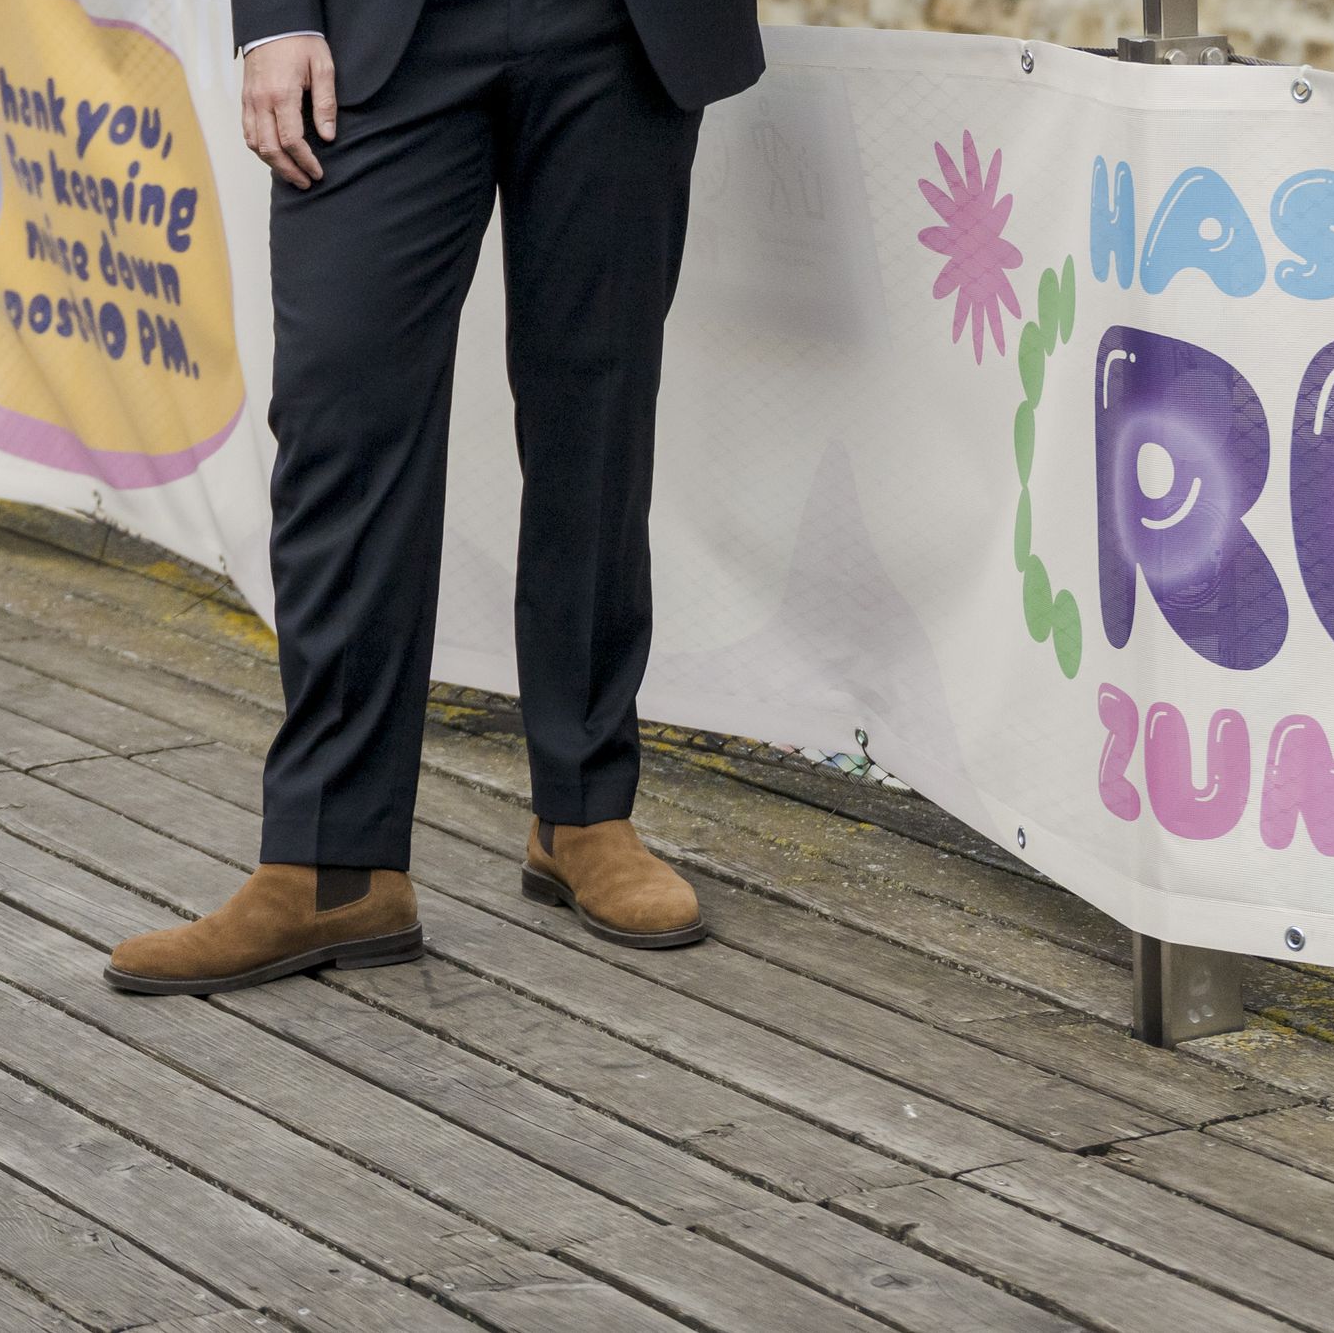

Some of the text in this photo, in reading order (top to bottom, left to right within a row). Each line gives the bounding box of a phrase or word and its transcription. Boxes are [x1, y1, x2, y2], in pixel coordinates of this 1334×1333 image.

[76, 99, 173, 161] you,
[48, 149, 198, 253] keeping
[25, 213, 182, 307] nise down
[136, 308, 200, 381] PM.
